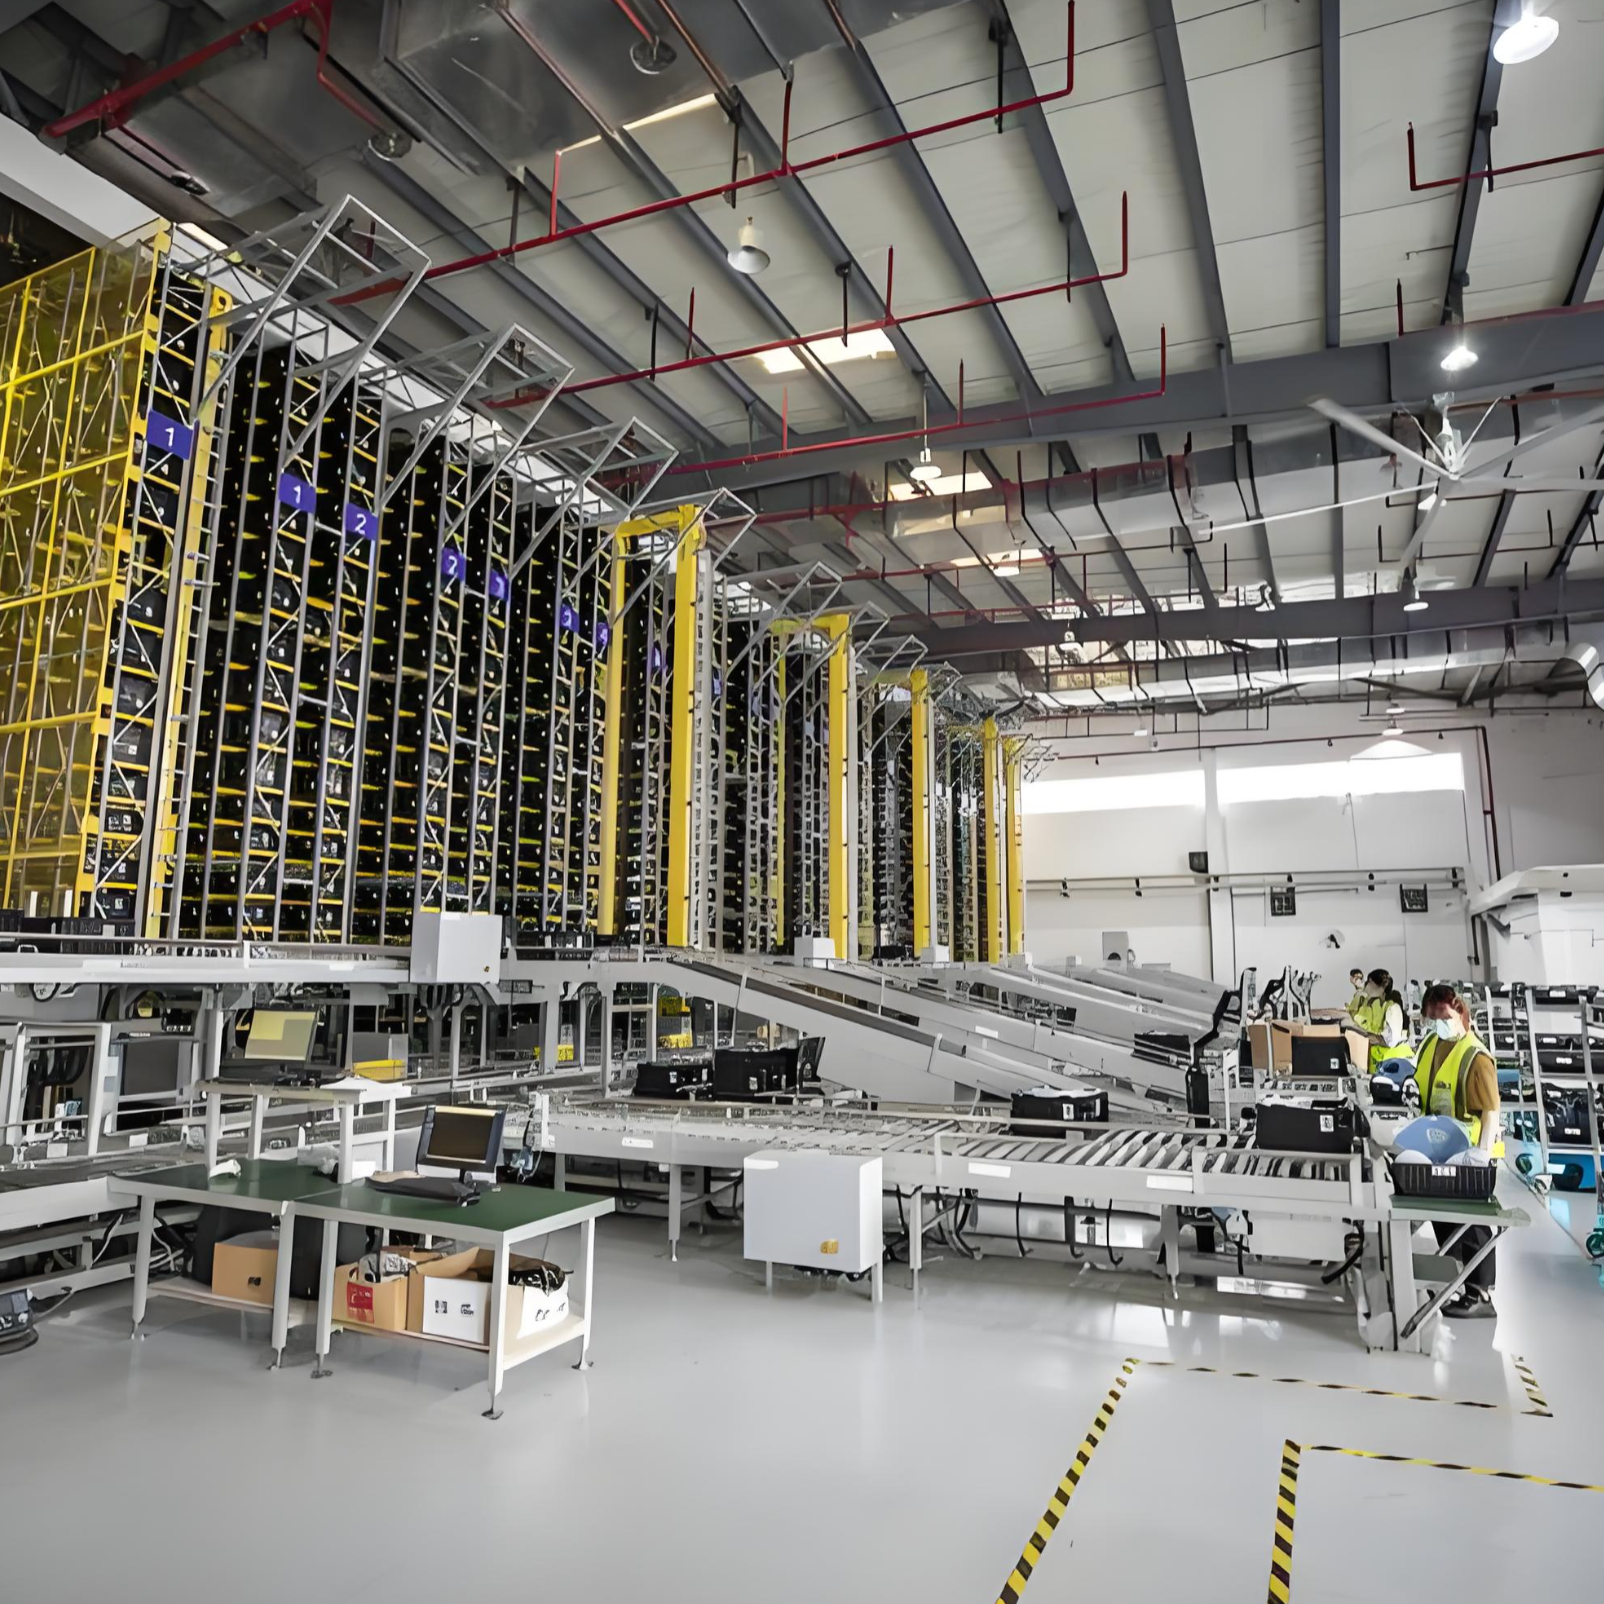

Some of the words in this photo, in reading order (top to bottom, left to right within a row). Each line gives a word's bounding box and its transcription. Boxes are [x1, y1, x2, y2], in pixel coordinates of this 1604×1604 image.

[165, 427, 174, 447] 1
[293, 485, 301, 504] 1
[355, 513, 367, 536] 2
